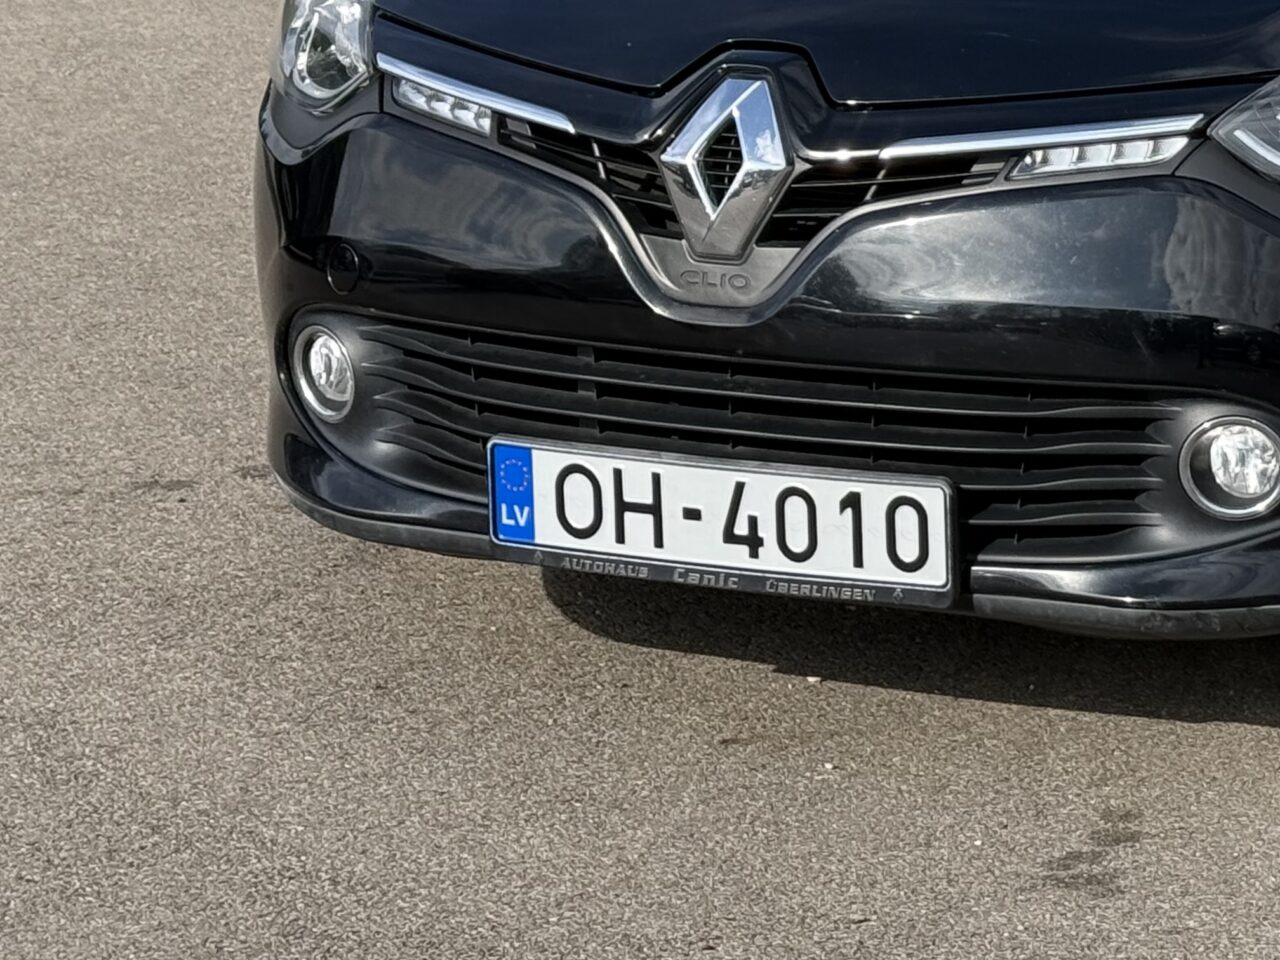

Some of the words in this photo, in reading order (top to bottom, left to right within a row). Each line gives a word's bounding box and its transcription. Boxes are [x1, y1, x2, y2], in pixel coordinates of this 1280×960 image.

[680, 269, 751, 290] CLIO
[501, 503, 530, 527] LV
[554, 462, 929, 573] OH-4010
[560, 556, 649, 578] AUTOHAUS
